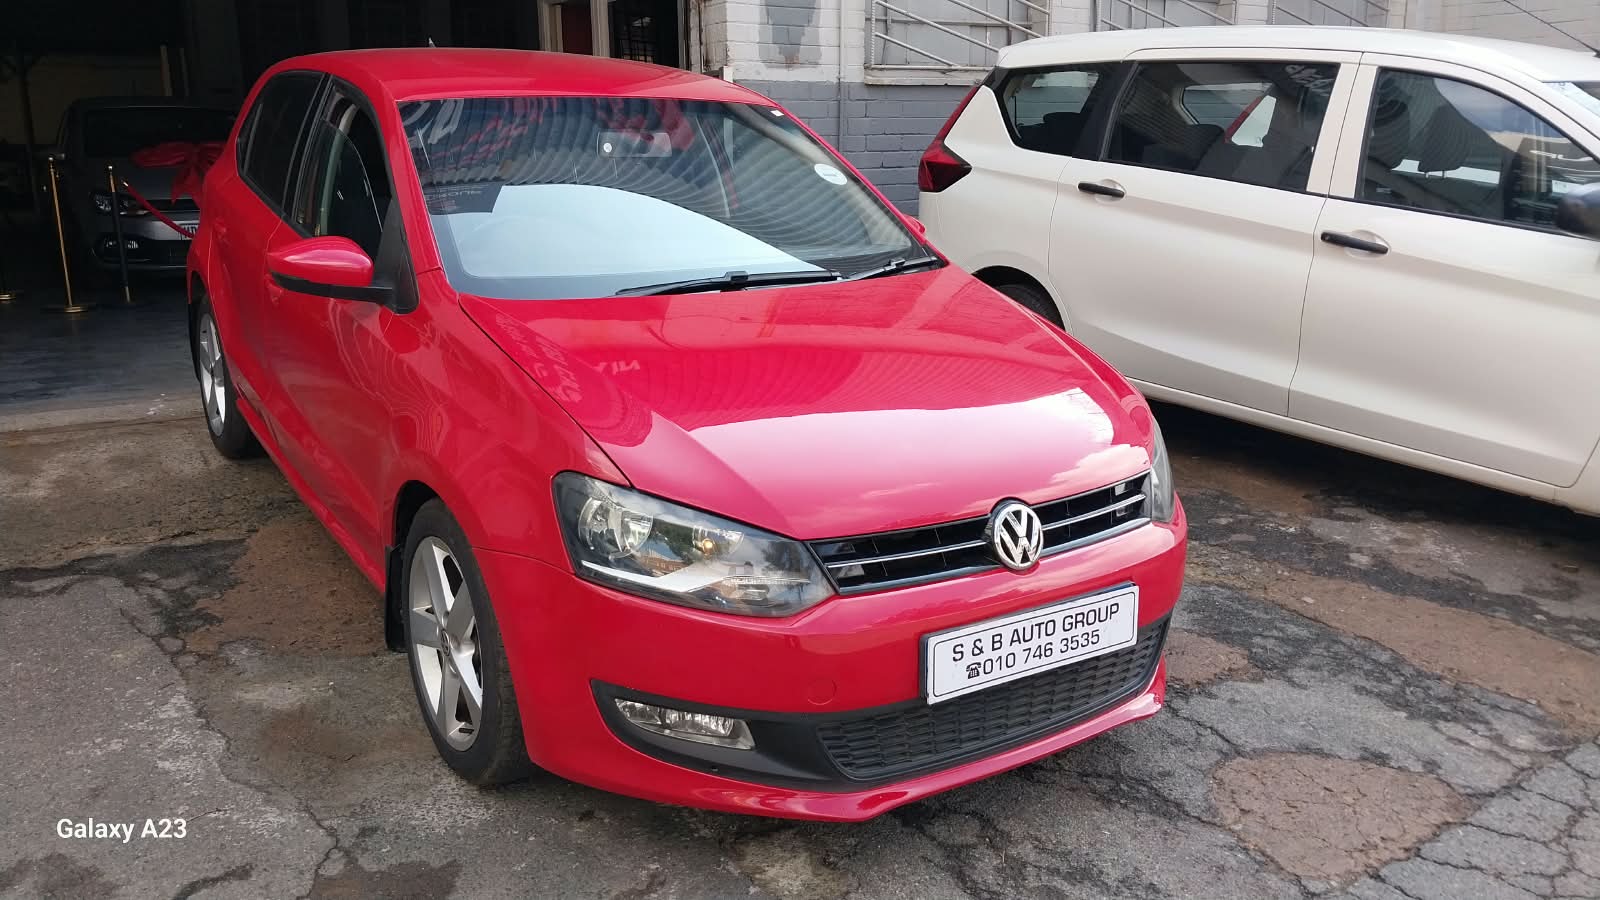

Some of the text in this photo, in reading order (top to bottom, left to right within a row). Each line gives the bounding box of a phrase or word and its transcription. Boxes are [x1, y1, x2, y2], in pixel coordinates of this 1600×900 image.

[995, 504, 1043, 570] VW
[952, 602, 1120, 662] S & B AUTO GROUP
[983, 629, 1100, 675] 010 746 3535
